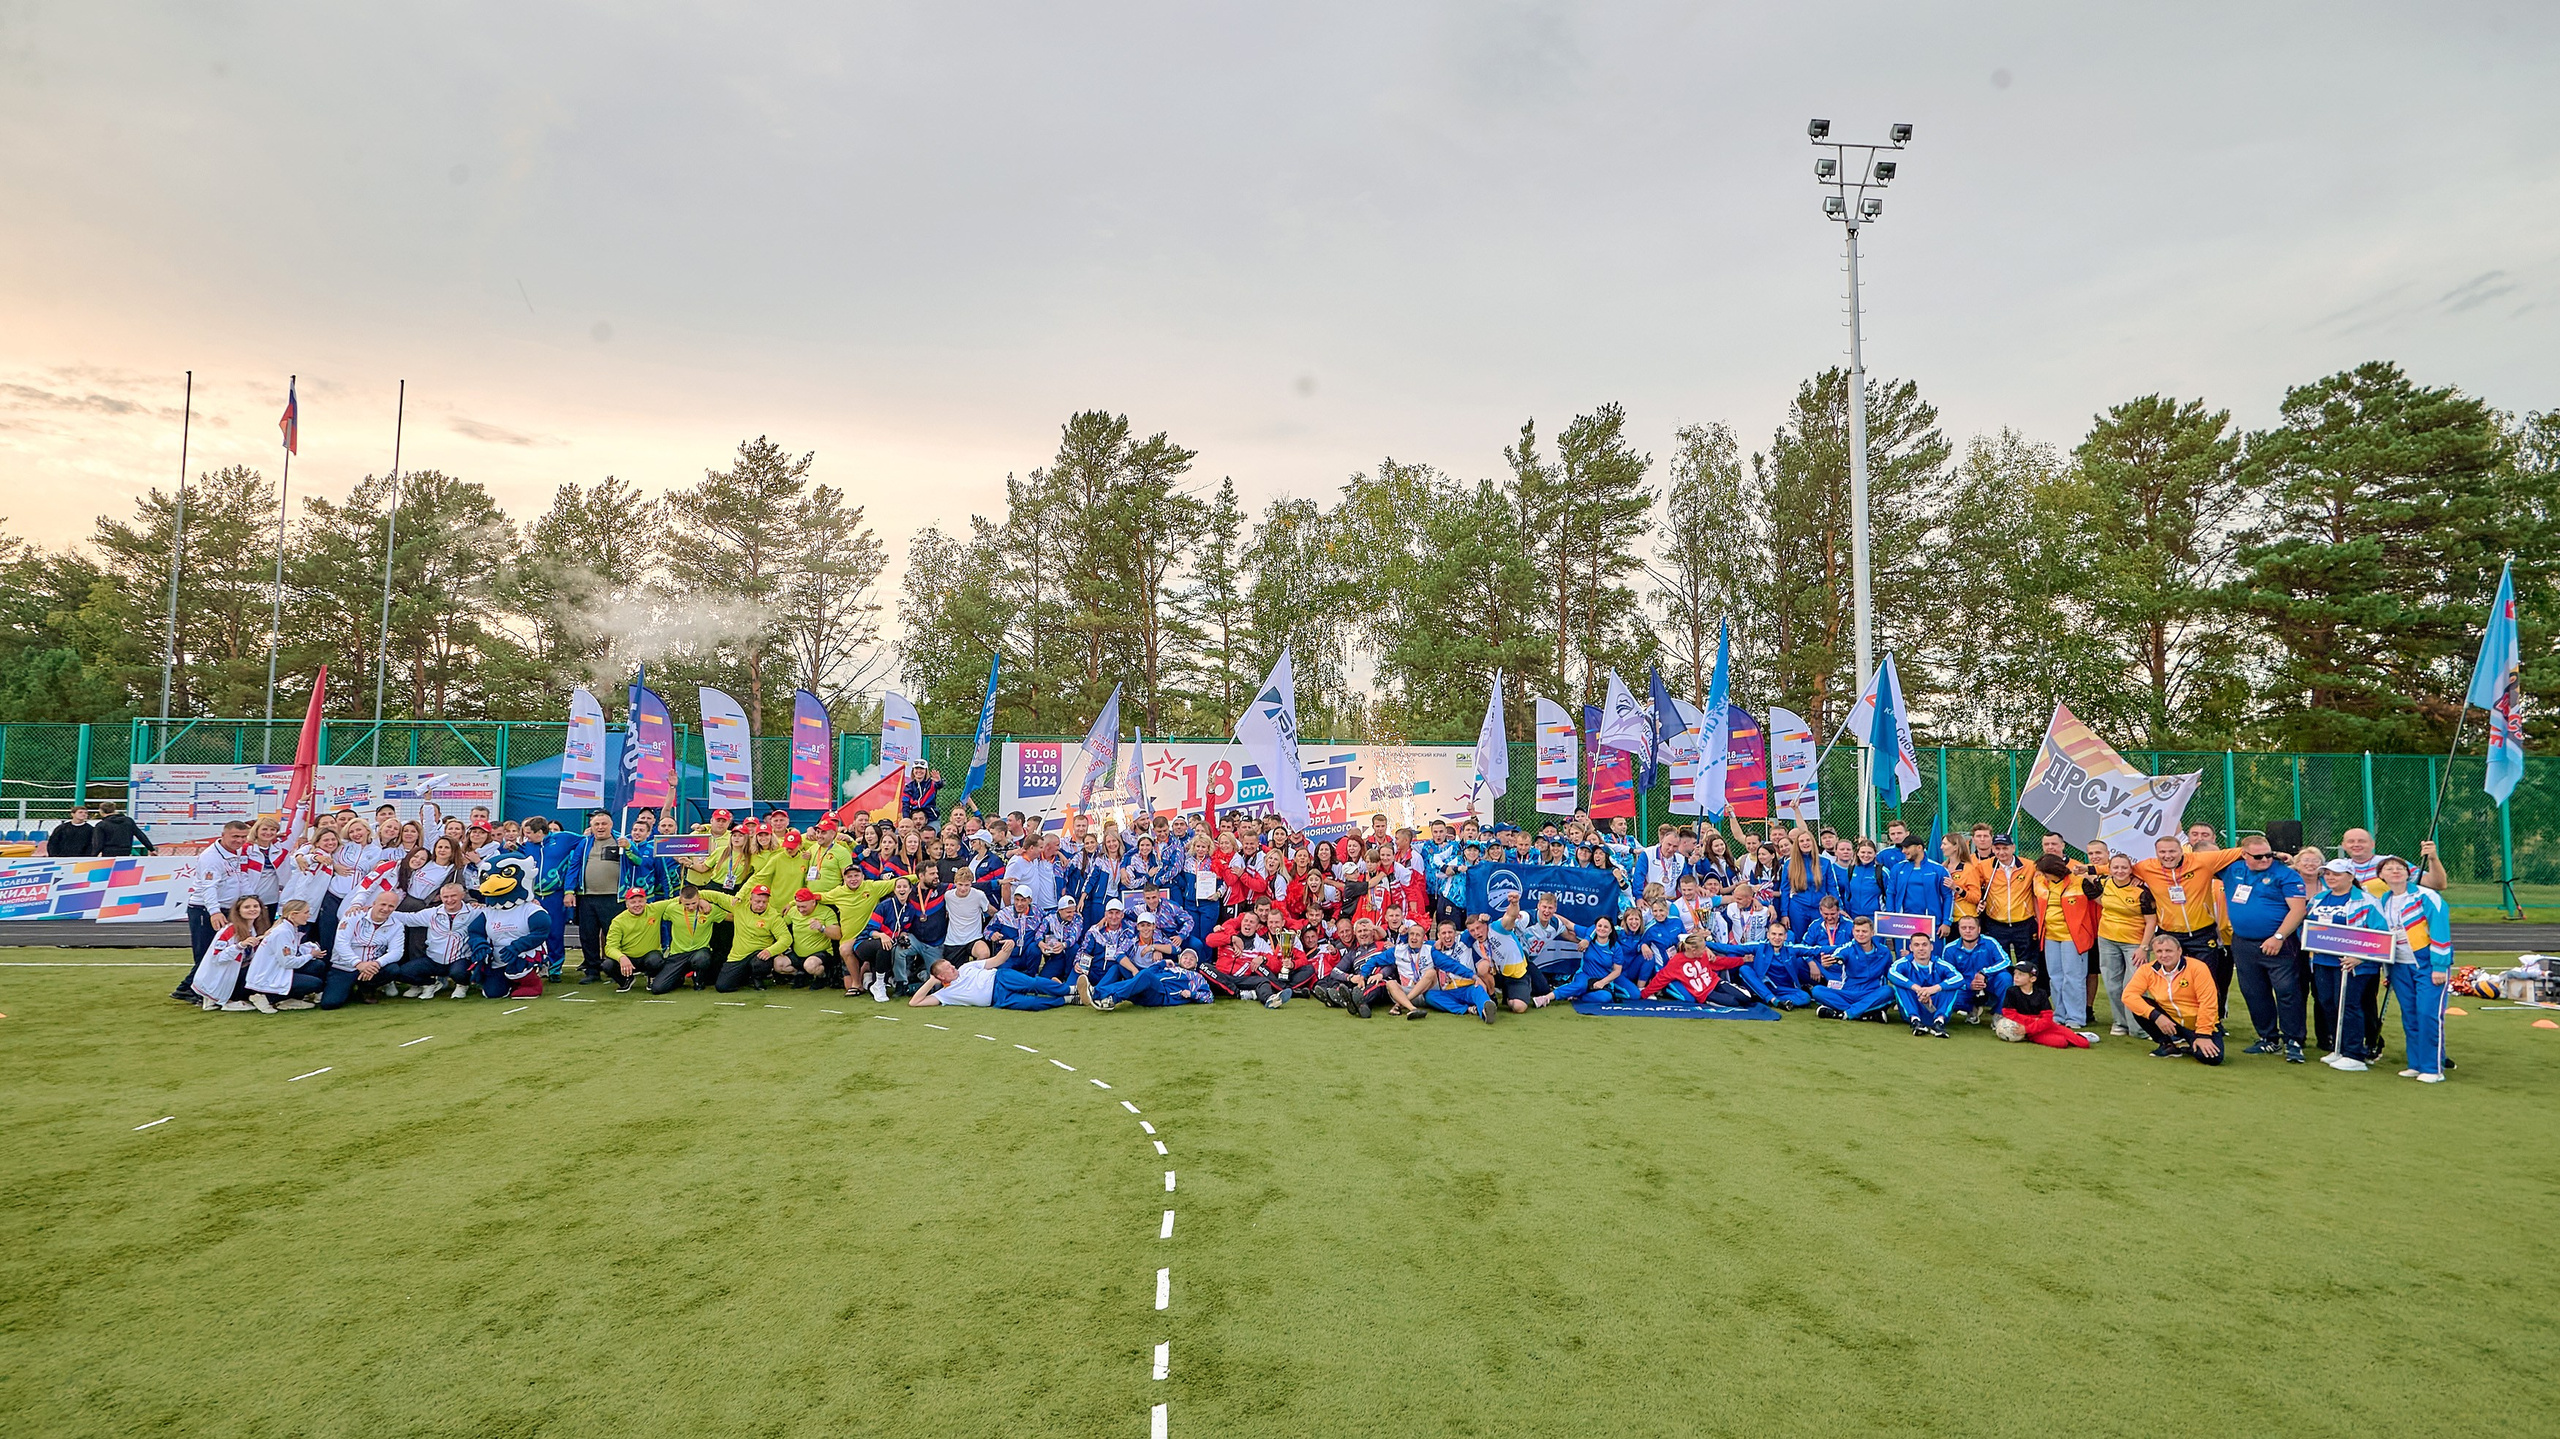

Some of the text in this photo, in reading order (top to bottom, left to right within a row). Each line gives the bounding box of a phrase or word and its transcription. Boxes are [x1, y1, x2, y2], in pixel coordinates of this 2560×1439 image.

[1024, 749, 1057, 759] 30.08
[1540, 746, 1548, 755] 18
[1674, 748, 1684, 756] 18
[1727, 750, 1736, 759] 18
[1778, 754, 1788, 762] 18
[1024, 764, 1057, 774] 31.08
[1023, 776, 1057, 788] 2024
[1182, 760, 1235, 809] 18
[333, 786, 345, 797] 18
[2042, 752, 2163, 837] ДРСУ-10
[2362, 941, 2382, 949] ДРСУ
